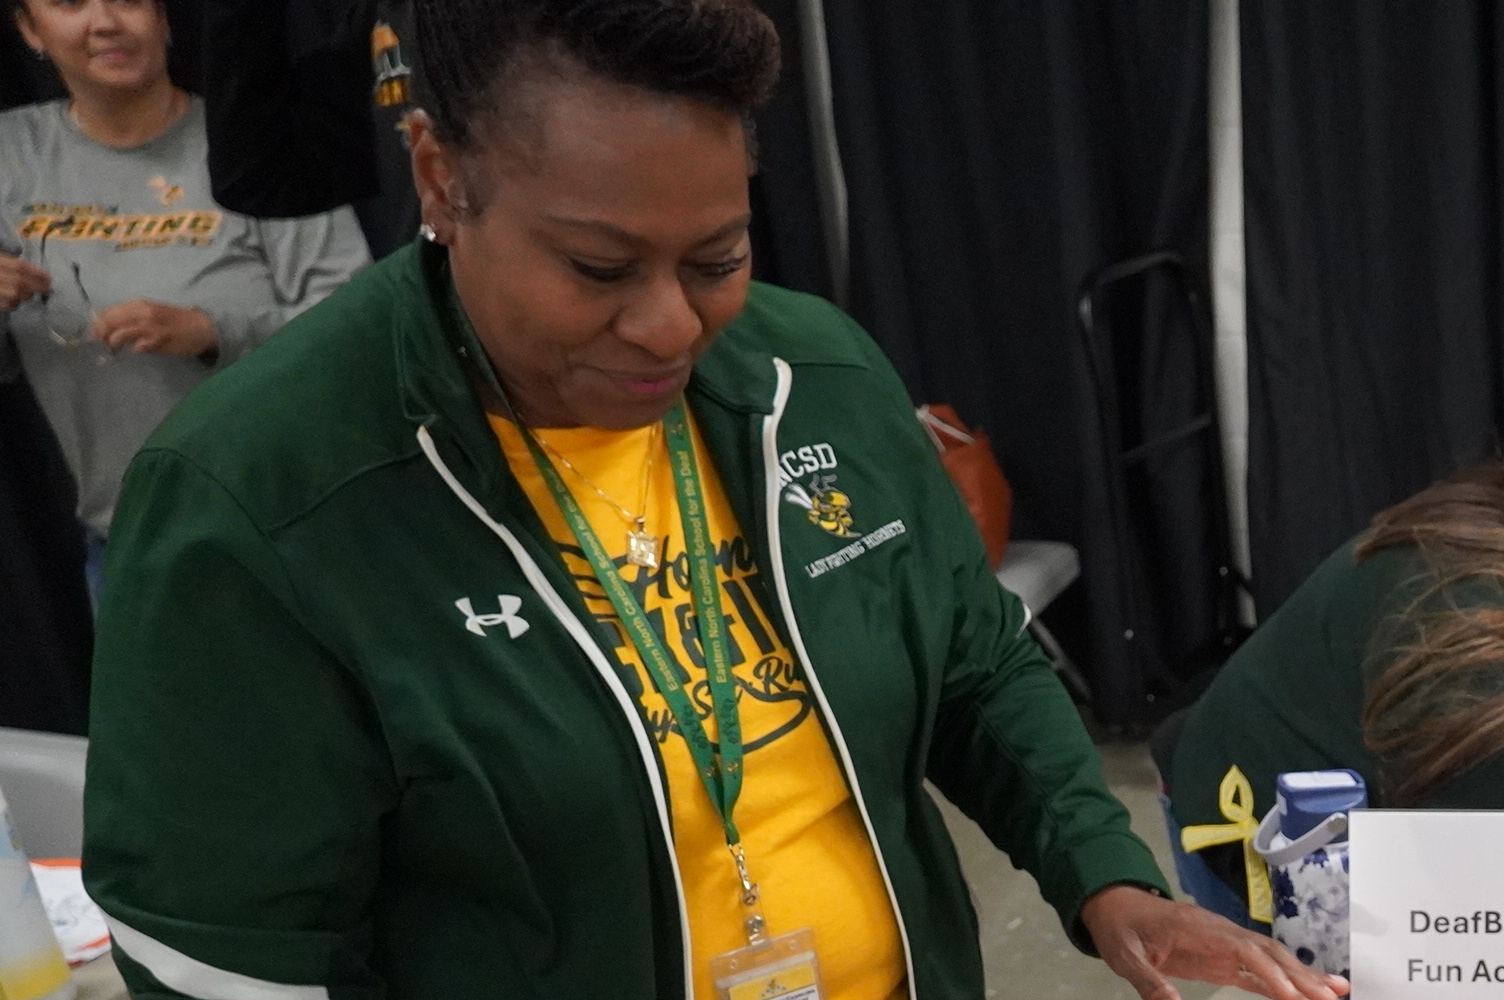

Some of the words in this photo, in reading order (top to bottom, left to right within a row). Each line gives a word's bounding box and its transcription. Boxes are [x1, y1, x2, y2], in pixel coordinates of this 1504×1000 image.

[677, 451, 692, 476] Deaf
[683, 480, 695, 497] the
[687, 500, 699, 515] for
[583, 531, 610, 569] School
[691, 517, 706, 555] School
[607, 570, 637, 615] Carolina
[699, 558, 716, 605] Carolina
[632, 616, 655, 648] North
[708, 605, 723, 639] North
[652, 648, 680, 692] Eastern
[713, 643, 728, 683] Eastern
[1407, 959, 1462, 982] Fun
